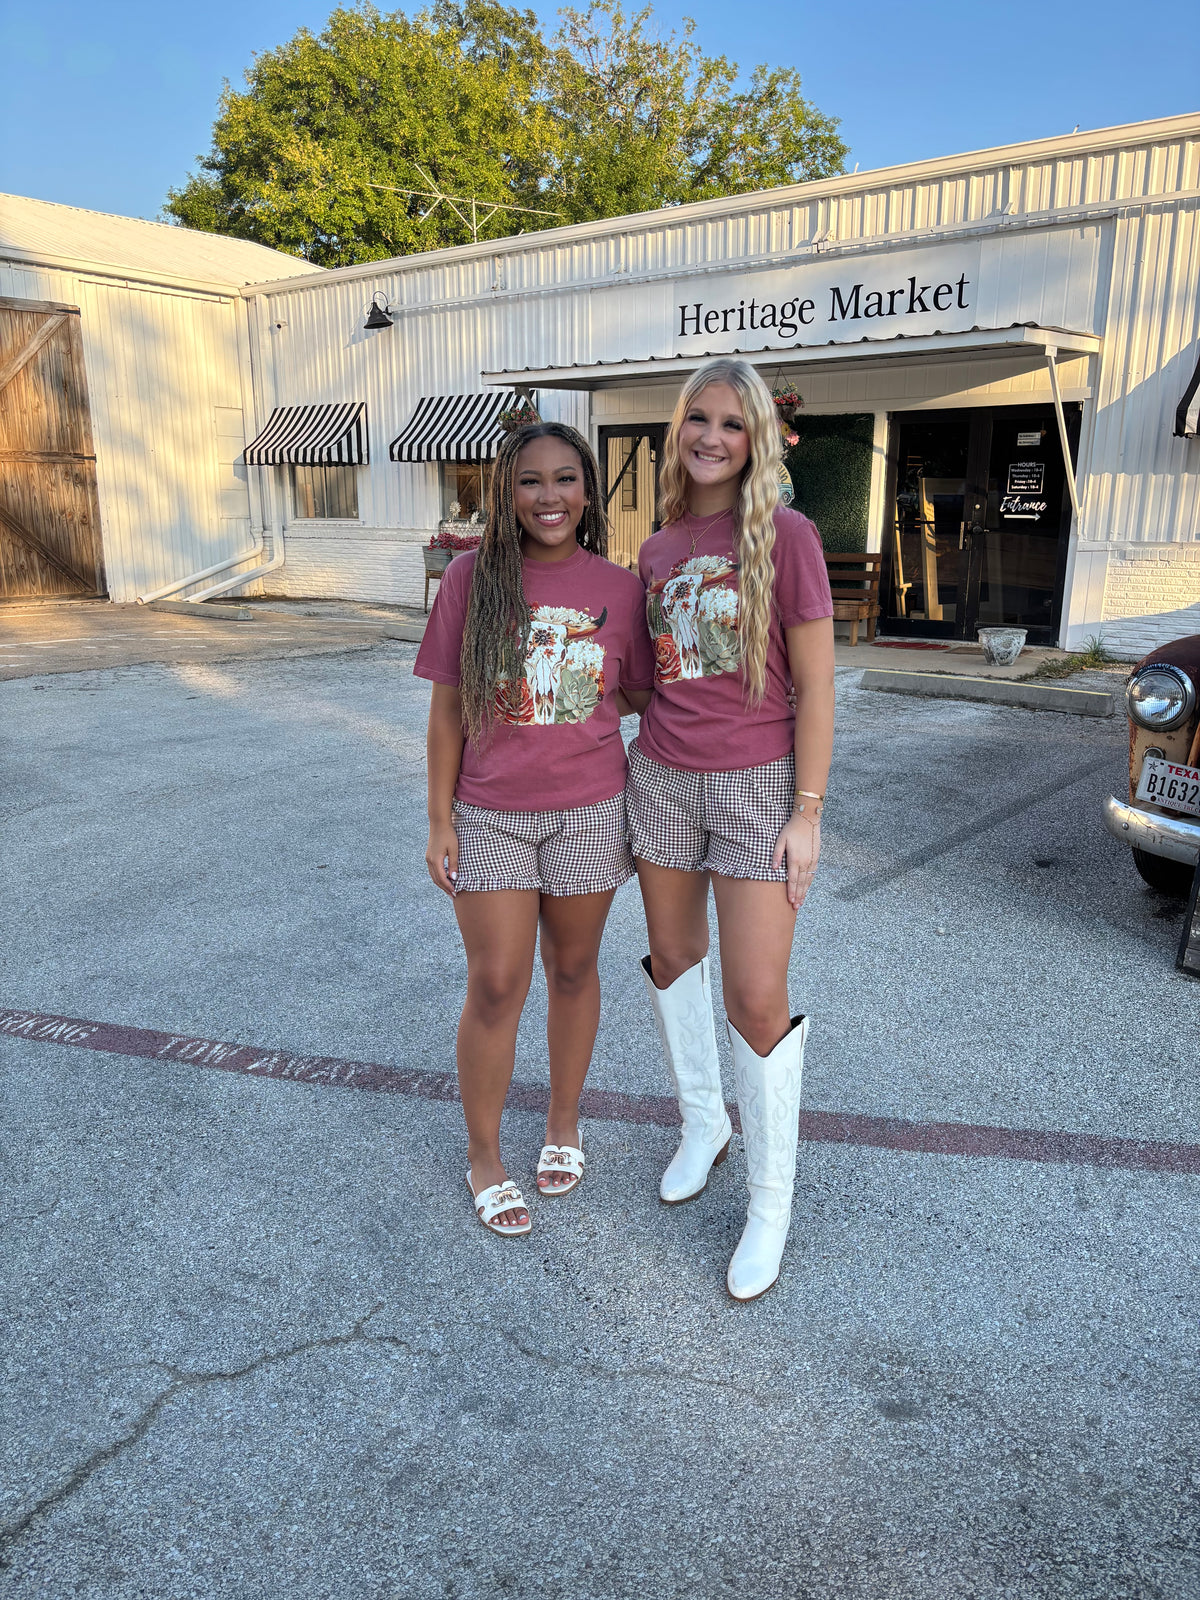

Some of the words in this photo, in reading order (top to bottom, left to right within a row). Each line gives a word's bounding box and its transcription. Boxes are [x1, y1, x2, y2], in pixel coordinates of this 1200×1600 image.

[678, 298, 815, 338] Heritage
[828, 273, 970, 322] Market
[1000, 496, 1047, 512] Entrance
[1168, 764, 1200, 782] TEXA
[1147, 773, 1200, 806] B1632
[157, 1036, 244, 1064] TOW
